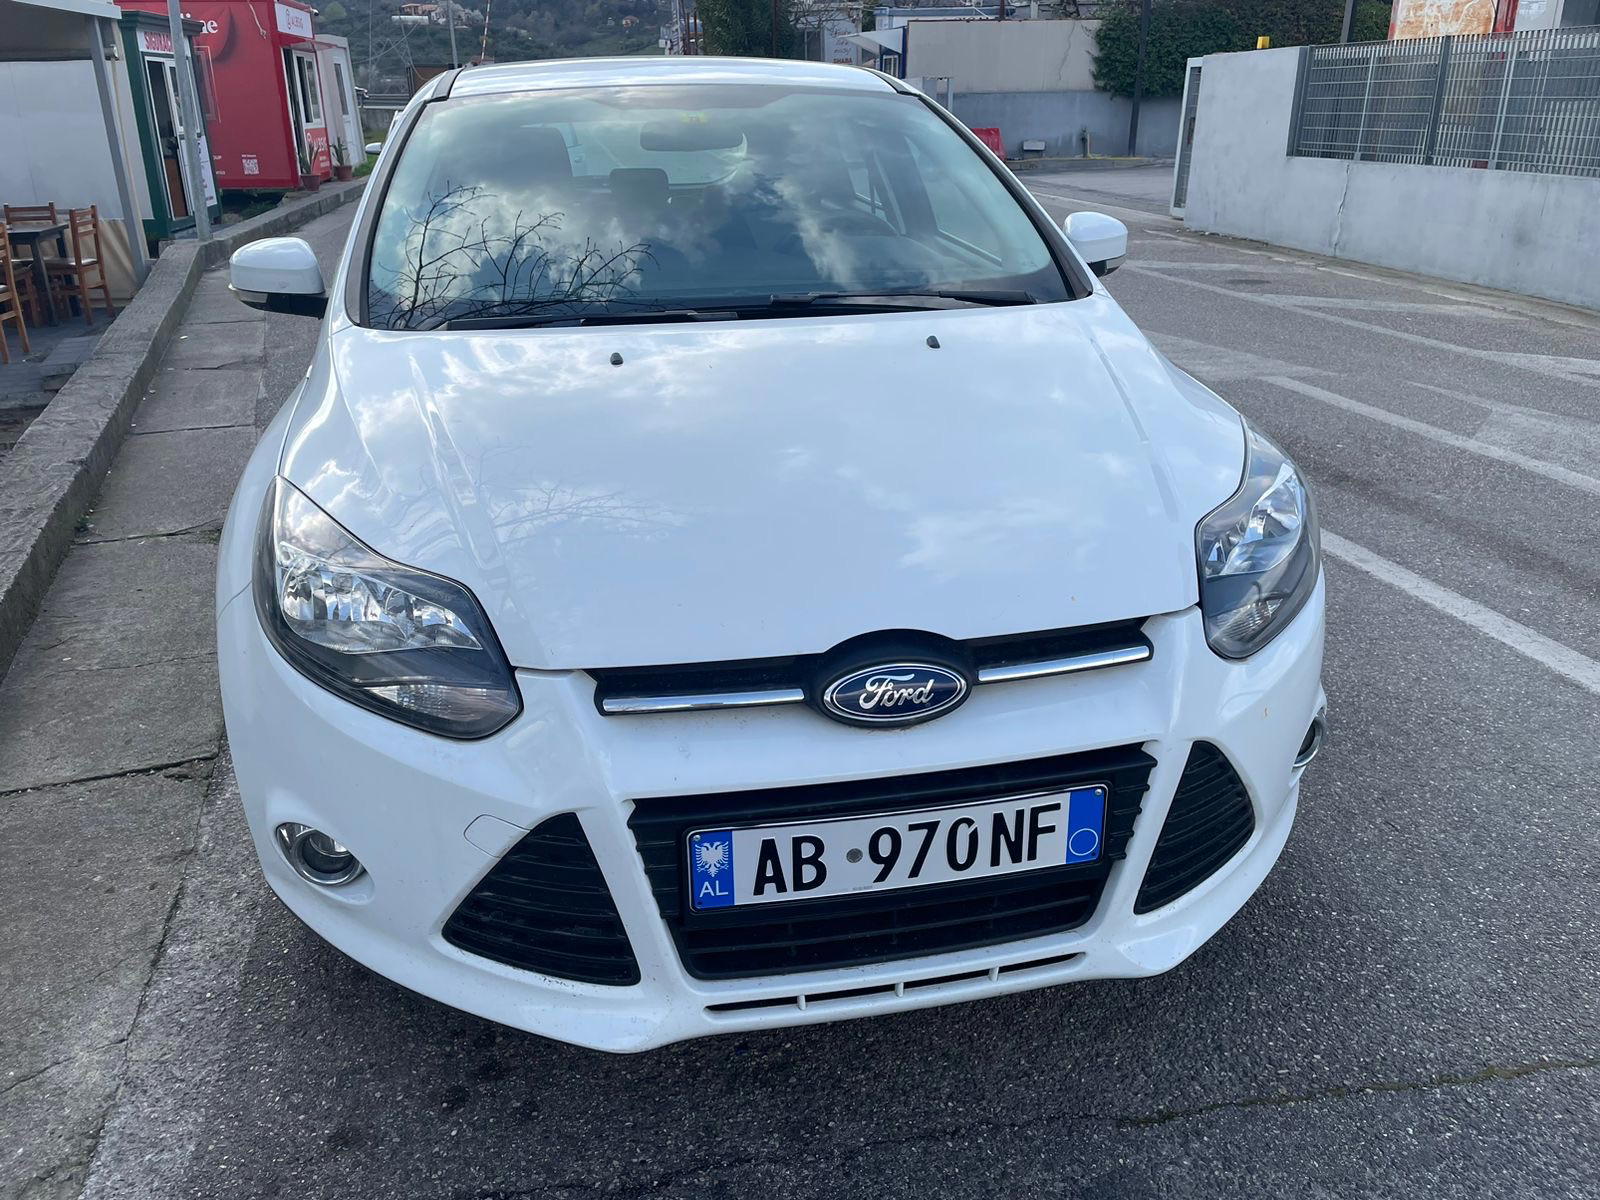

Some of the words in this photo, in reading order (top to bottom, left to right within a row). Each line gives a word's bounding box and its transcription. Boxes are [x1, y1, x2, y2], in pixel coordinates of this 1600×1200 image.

[859, 673, 935, 710] Ford
[752, 835, 828, 896] AB
[868, 816, 979, 884] 970
[989, 802, 1062, 868] NF
[699, 880, 729, 897] AL
